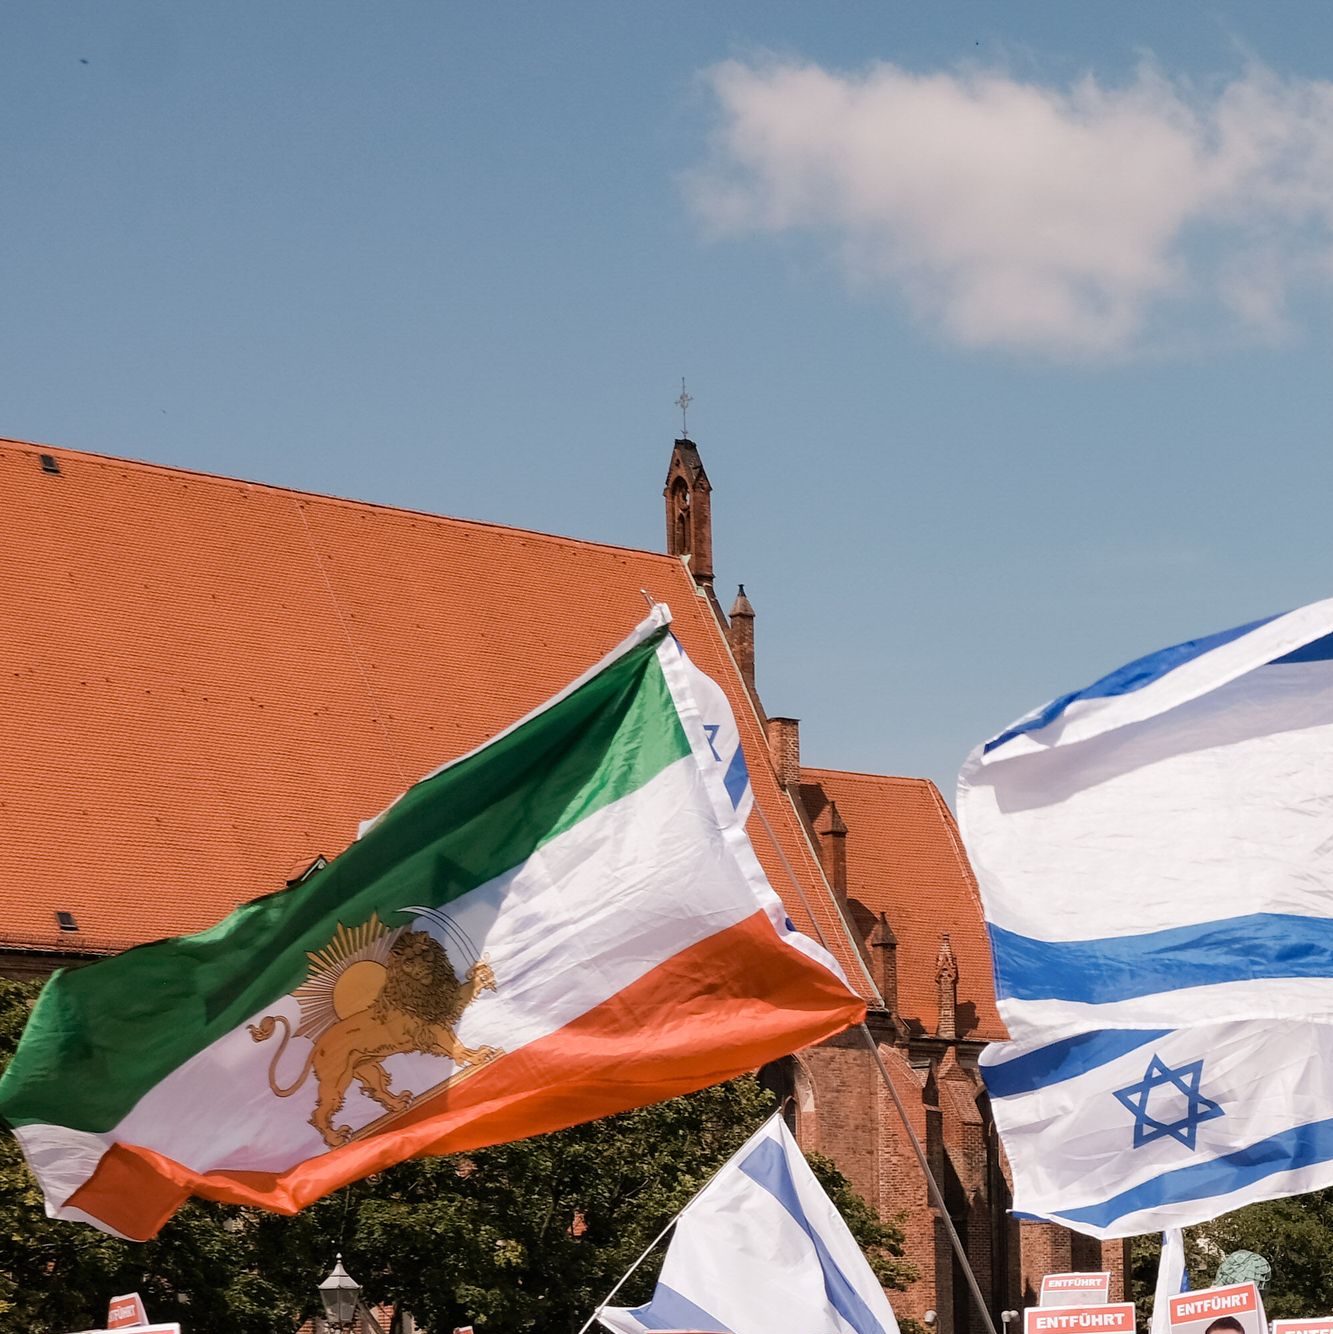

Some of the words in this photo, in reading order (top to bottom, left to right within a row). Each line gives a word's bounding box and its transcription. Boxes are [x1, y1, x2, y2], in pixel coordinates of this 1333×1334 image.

[1048, 1278, 1102, 1288] ENTFÜHRT
[1176, 1293, 1249, 1316] ENTFÜHRT
[1036, 1312, 1125, 1329] ENTFÜHRT
